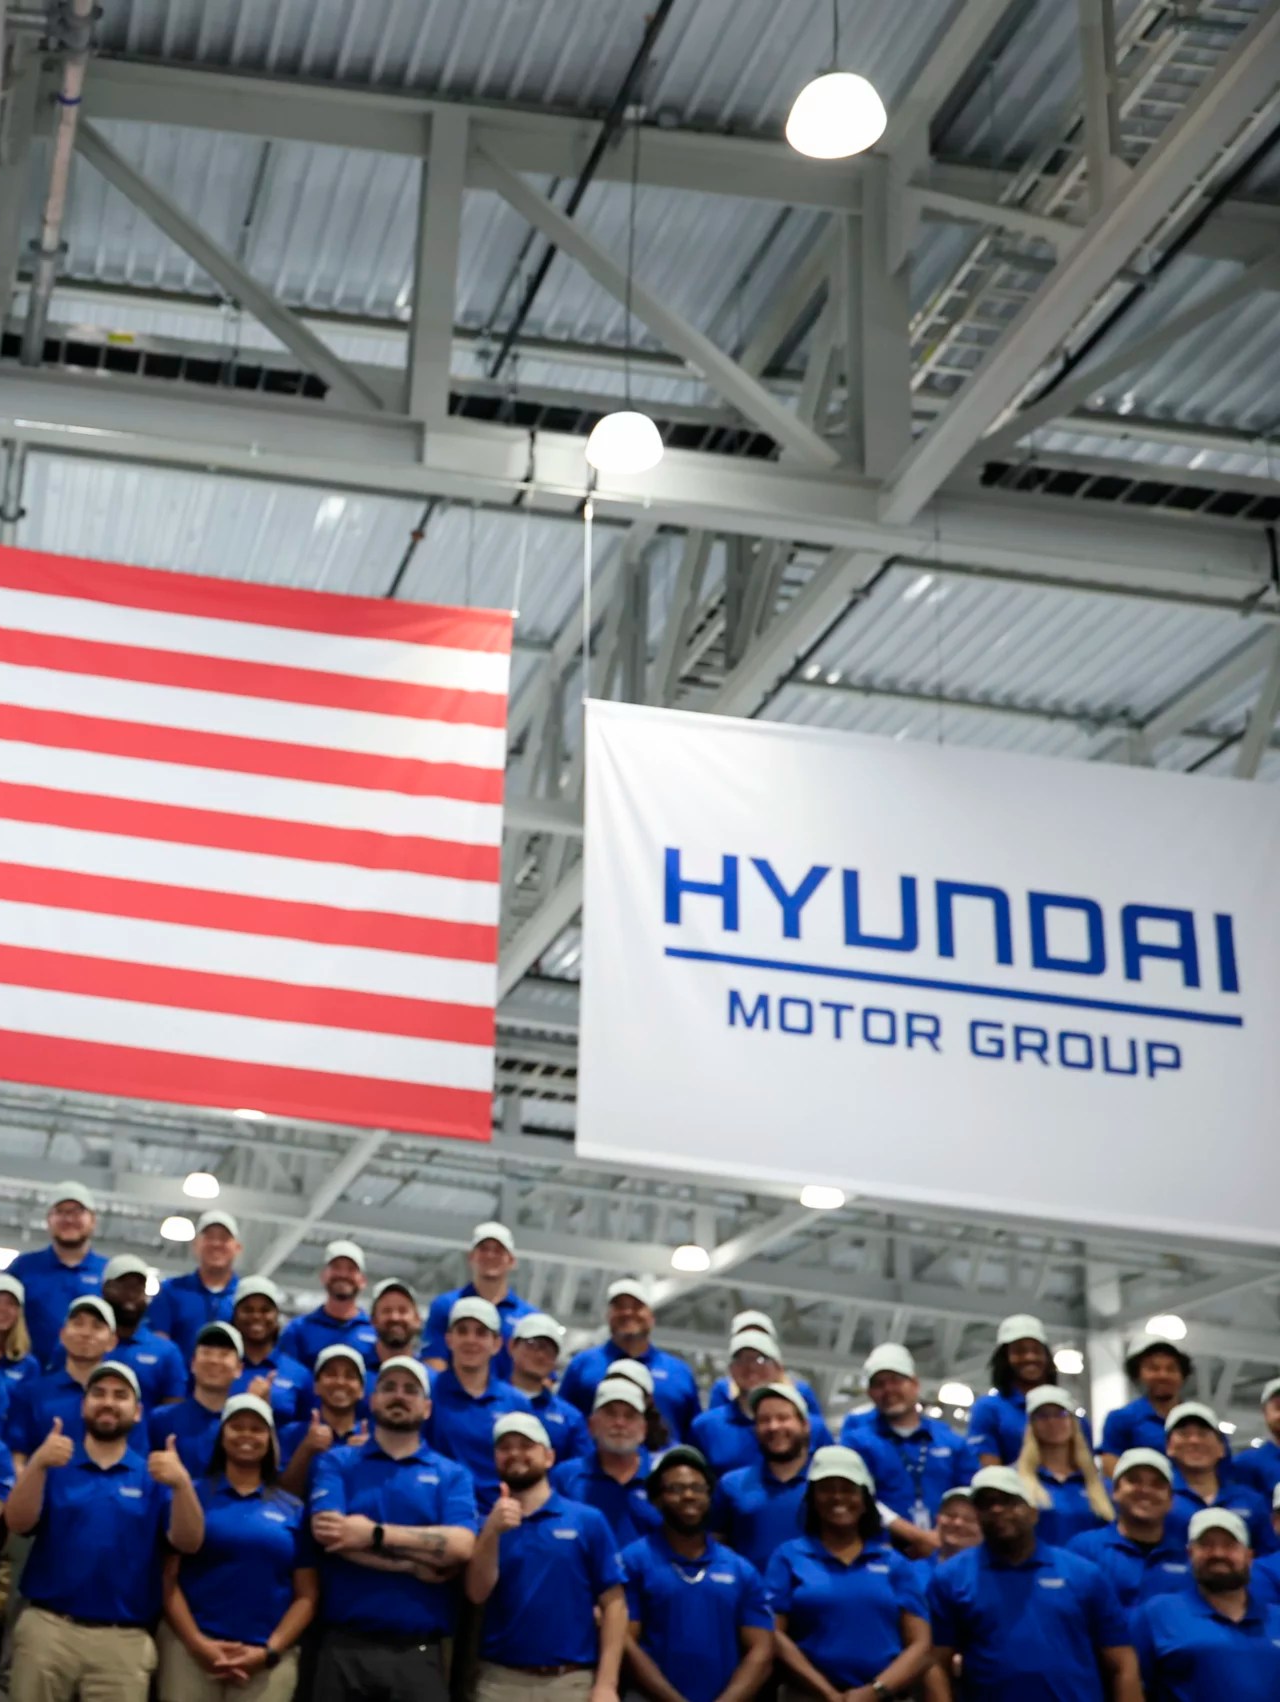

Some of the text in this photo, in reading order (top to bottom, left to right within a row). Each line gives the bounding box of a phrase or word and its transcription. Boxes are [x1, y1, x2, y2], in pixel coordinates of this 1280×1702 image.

[664, 846, 1240, 994] HYUNDAI
[728, 989, 1182, 1078] MOTOR GROUP
